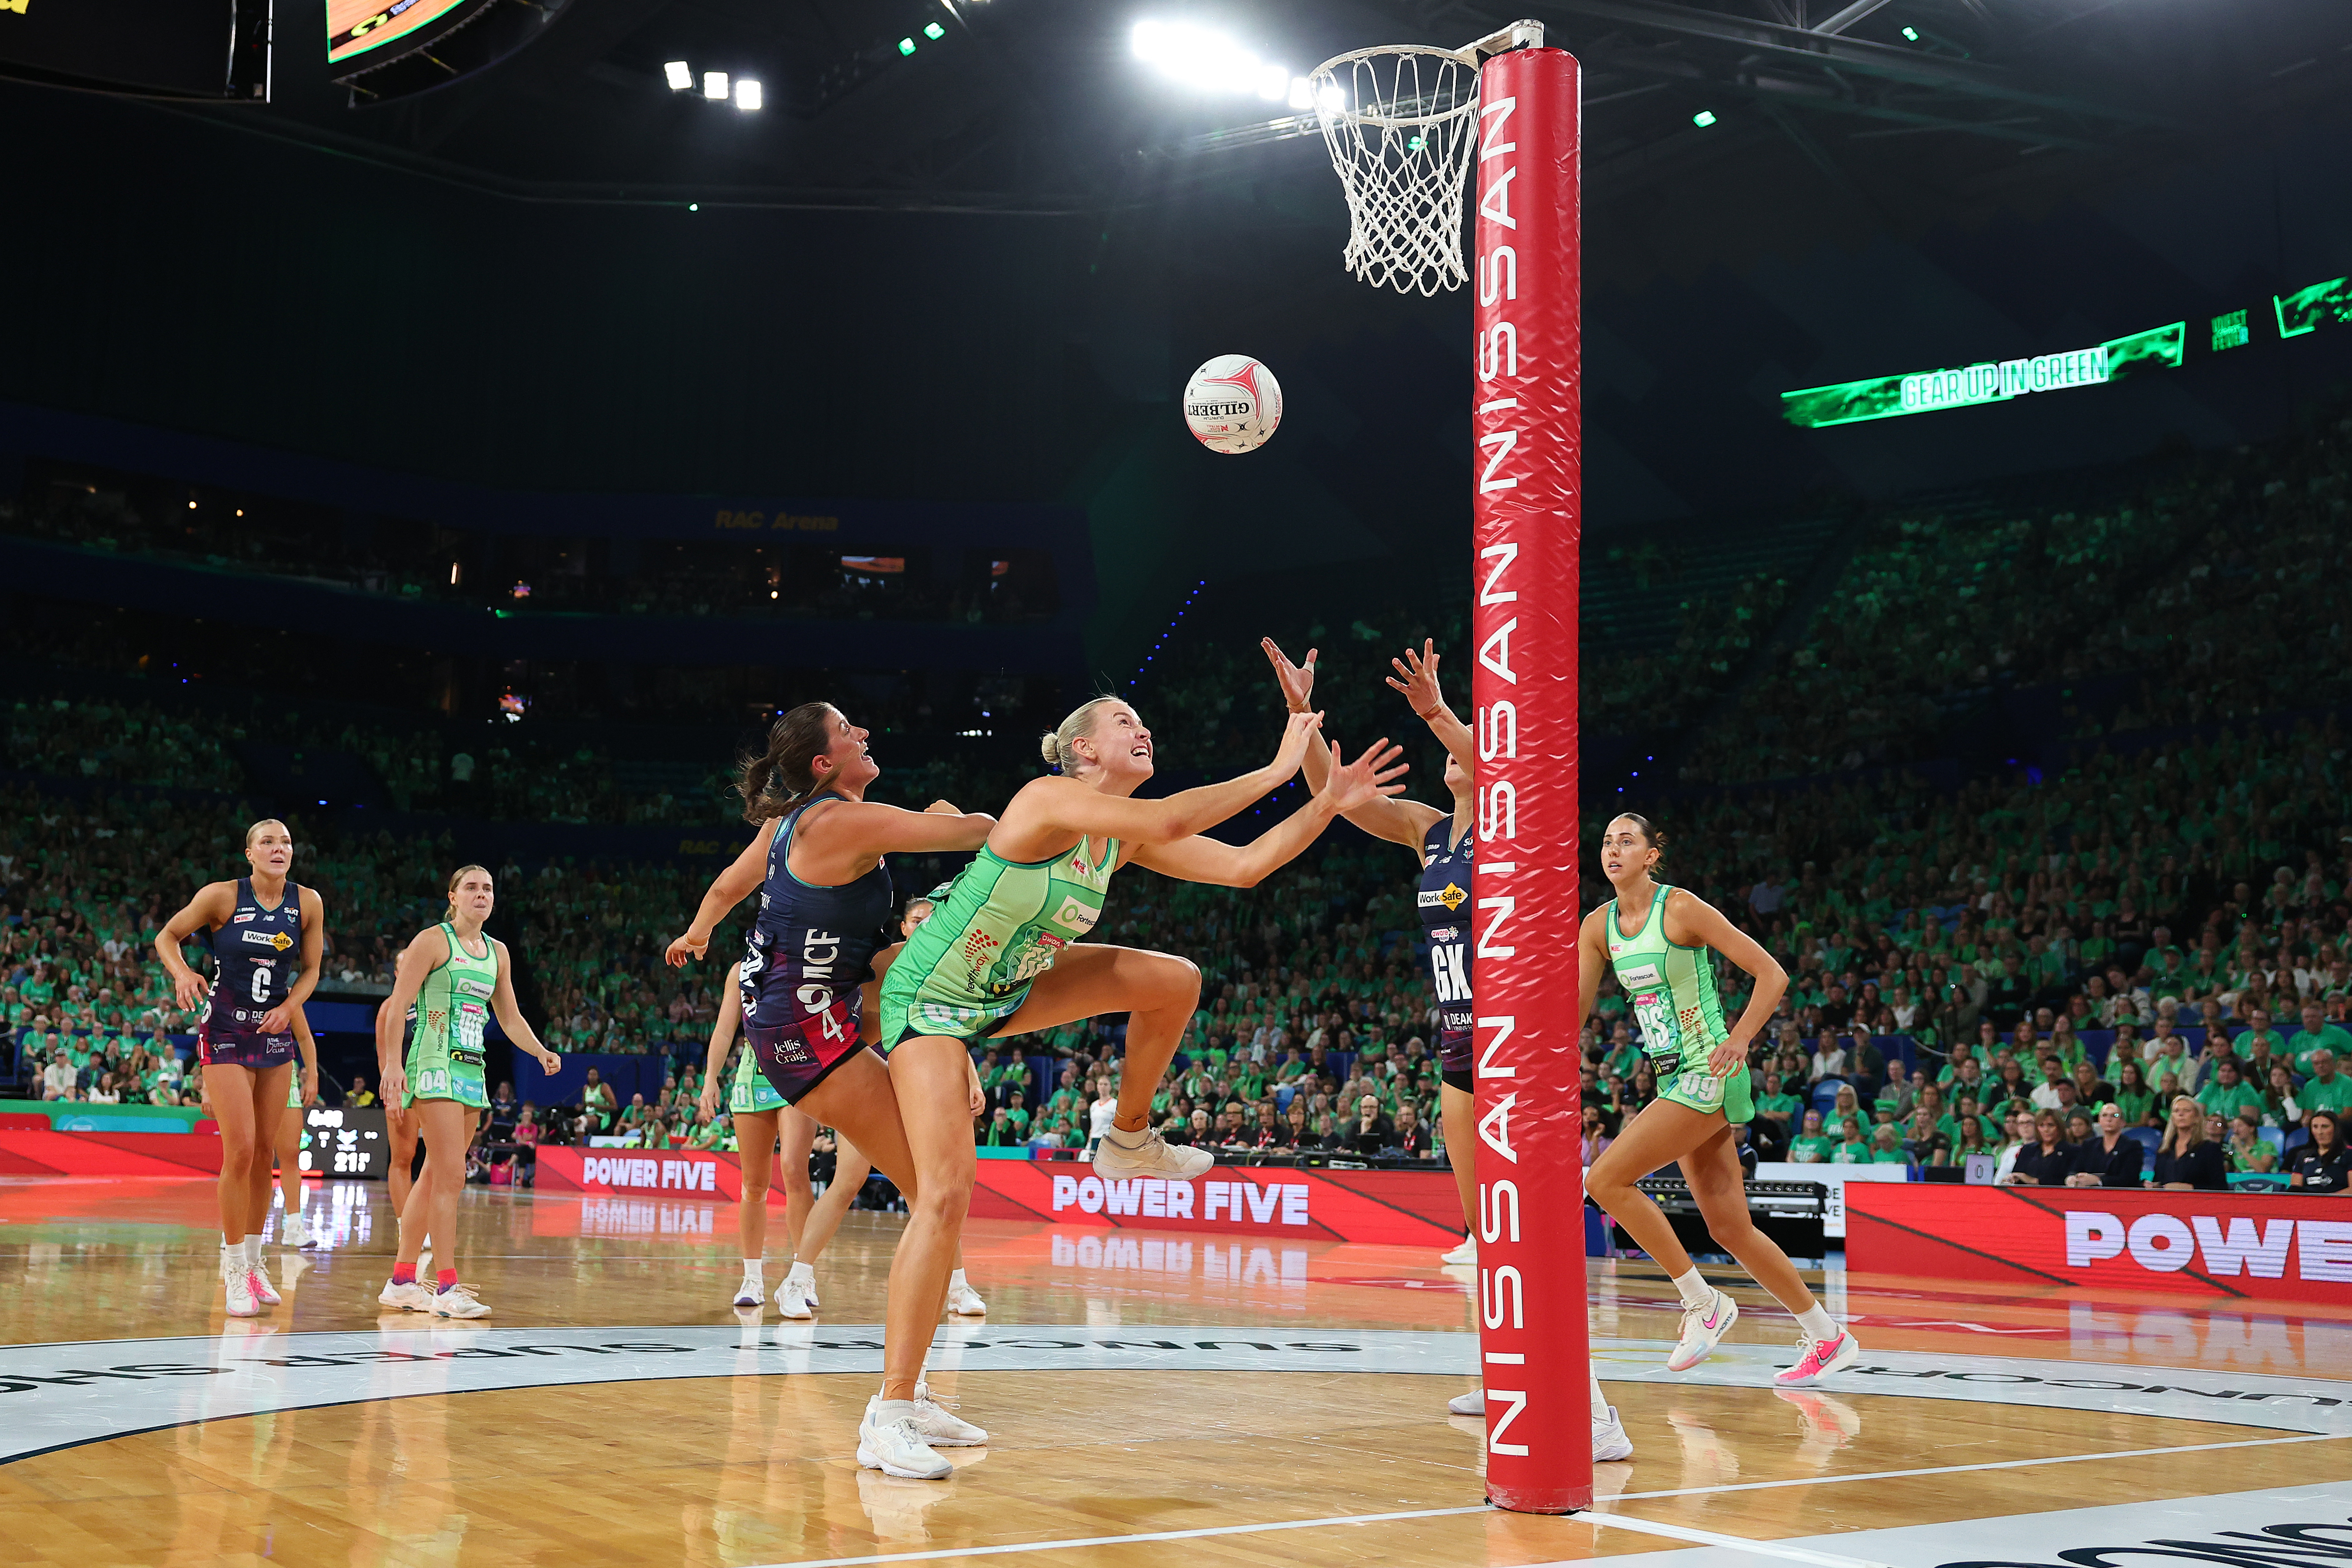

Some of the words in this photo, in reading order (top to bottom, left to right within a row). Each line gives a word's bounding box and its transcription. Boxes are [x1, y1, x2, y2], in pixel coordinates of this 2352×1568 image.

[1480, 96, 1517, 494] NISSAN
[1904, 372, 1961, 410] GEAR
[1965, 367, 1997, 401] UP
[2002, 361, 2027, 393] IN
[2033, 349, 2107, 390] GREEN
[1187, 402, 1249, 416] GILBERT
[715, 510, 765, 529] RAC
[771, 511, 839, 531] Arena
[1477, 542, 1518, 959] NISSAN
[252, 967, 271, 1003] C
[965, 953, 989, 993] healthway
[1431, 944, 1472, 1002] GK
[437, 1022, 446, 1052] healthway
[1637, 1006, 1670, 1050] GS
[1694, 1020, 1706, 1053] healthway
[773, 1039, 801, 1054] Jellis
[776, 1050, 807, 1065] Craig
[420, 1070, 446, 1091] 04
[1681, 1072, 1719, 1101] 09
[583, 1157, 658, 1188] POWER
[662, 1160, 716, 1191] FIVE
[1052, 1175, 1195, 1219] POWER
[1204, 1181, 1309, 1225] FIVE
[1478, 1015, 1529, 1456] NISSAN
[224, 1343, 697, 1367] SUPER
[1774, 1363, 2352, 1406] UNCOR
